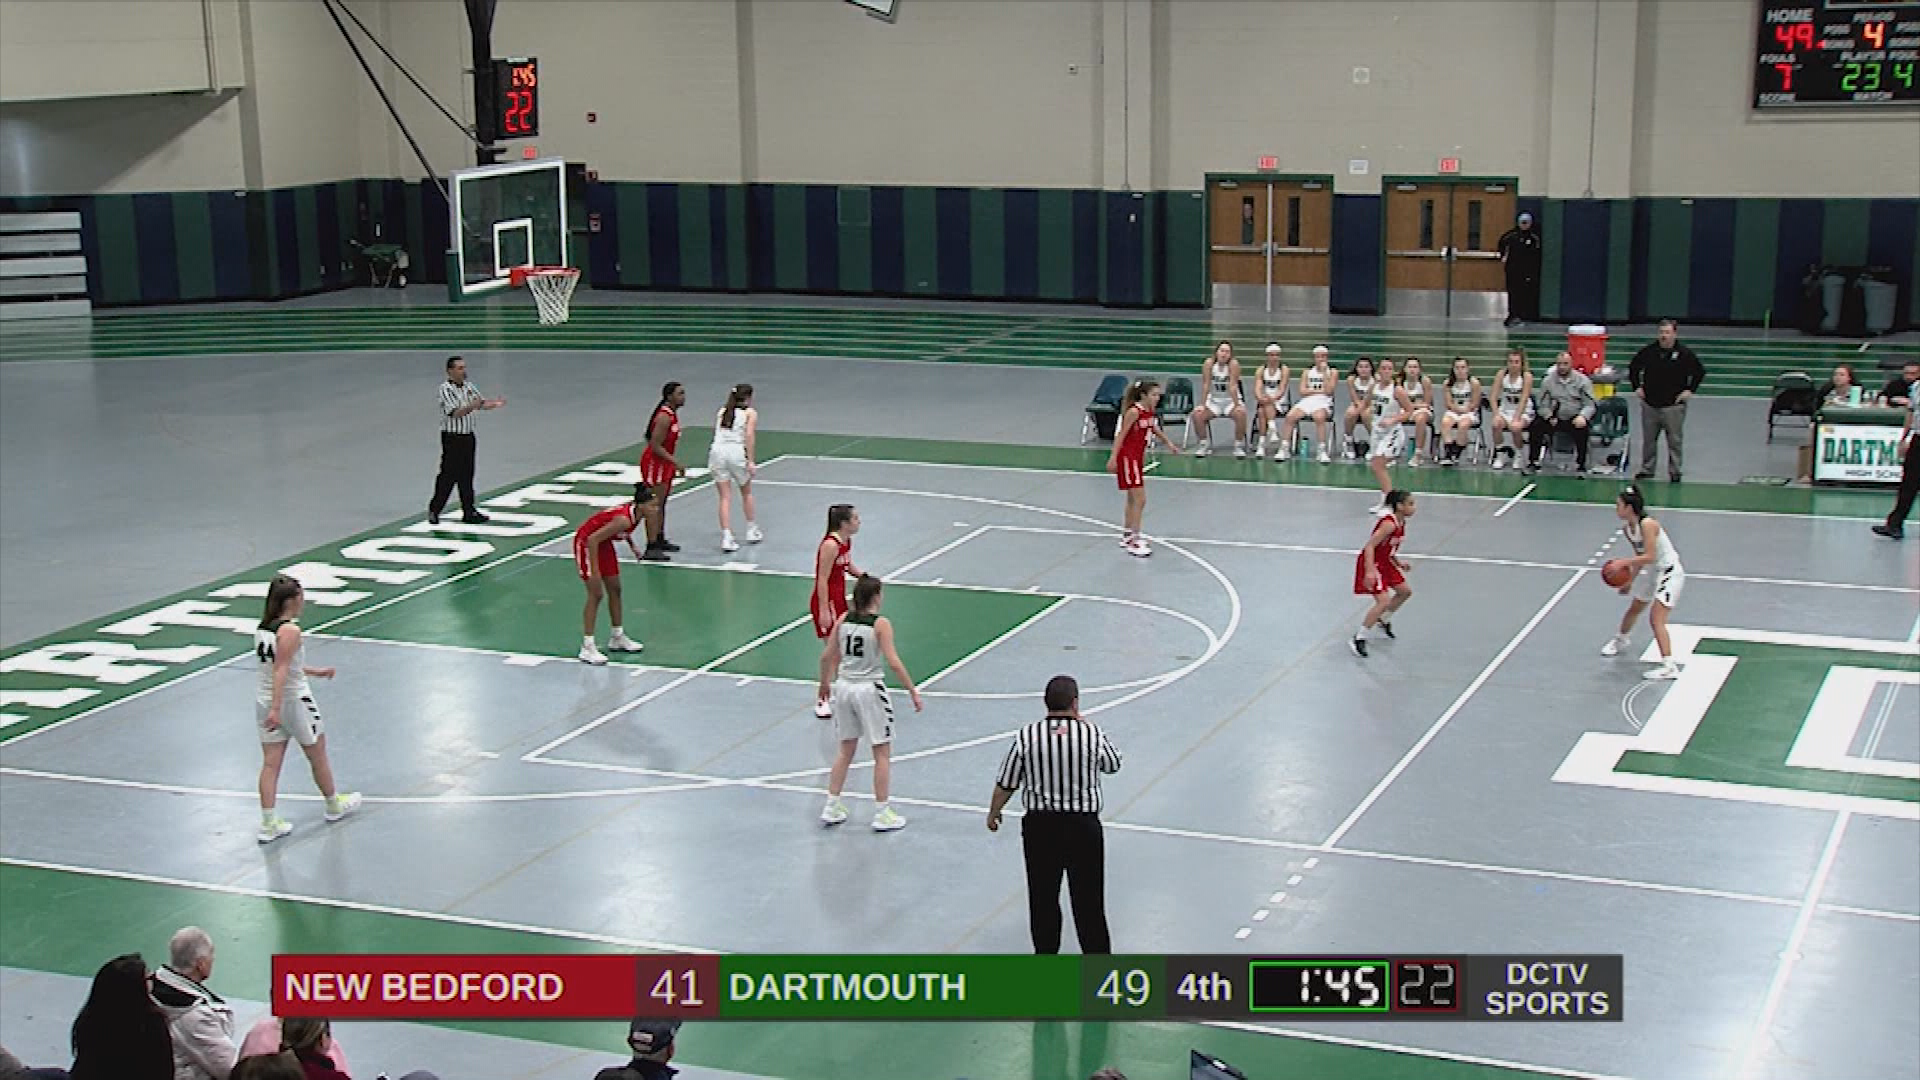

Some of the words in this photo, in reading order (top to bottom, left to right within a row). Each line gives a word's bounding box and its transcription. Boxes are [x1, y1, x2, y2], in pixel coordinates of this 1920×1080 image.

[1767, 8, 1814, 22] HOME
[1775, 24, 1814, 51] 49
[1864, 22, 1884, 49] 4
[1774, 63, 1793, 91] 7
[1841, 63, 1882, 91] 23
[1892, 63, 1914, 89] 4
[506, 91, 533, 132] 22
[256, 641, 275, 663] 44
[846, 634, 864, 657] 12
